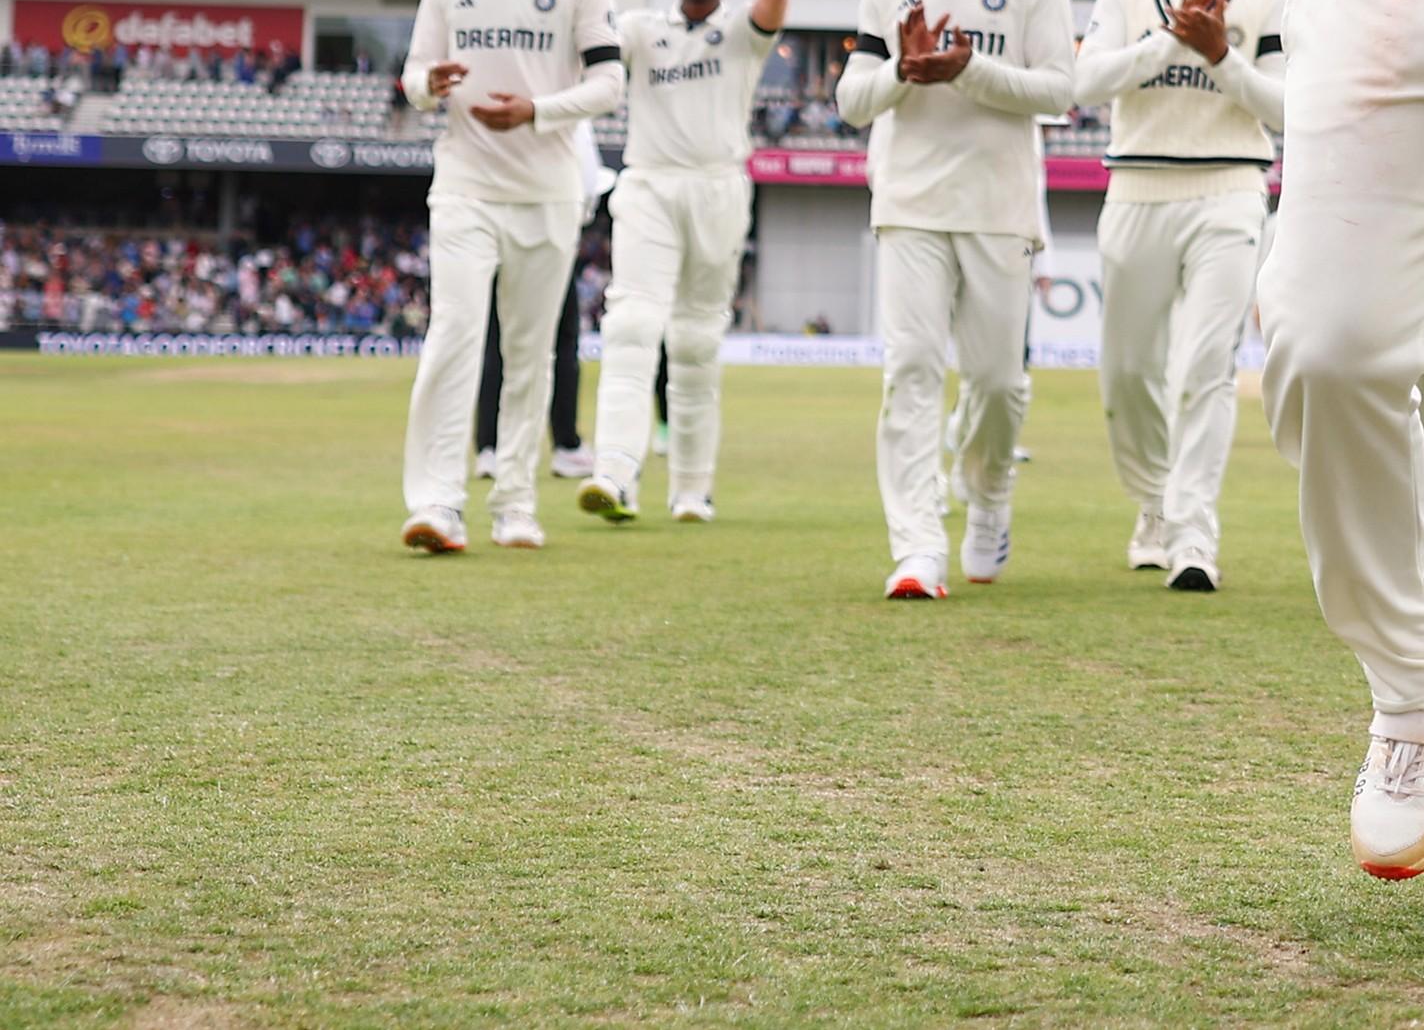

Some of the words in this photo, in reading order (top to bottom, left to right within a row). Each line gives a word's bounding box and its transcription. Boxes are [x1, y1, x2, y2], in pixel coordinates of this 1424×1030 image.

[114, 10, 253, 48] dafabet
[456, 28, 553, 50] DREAM11
[187, 139, 273, 163] TOYOTA
